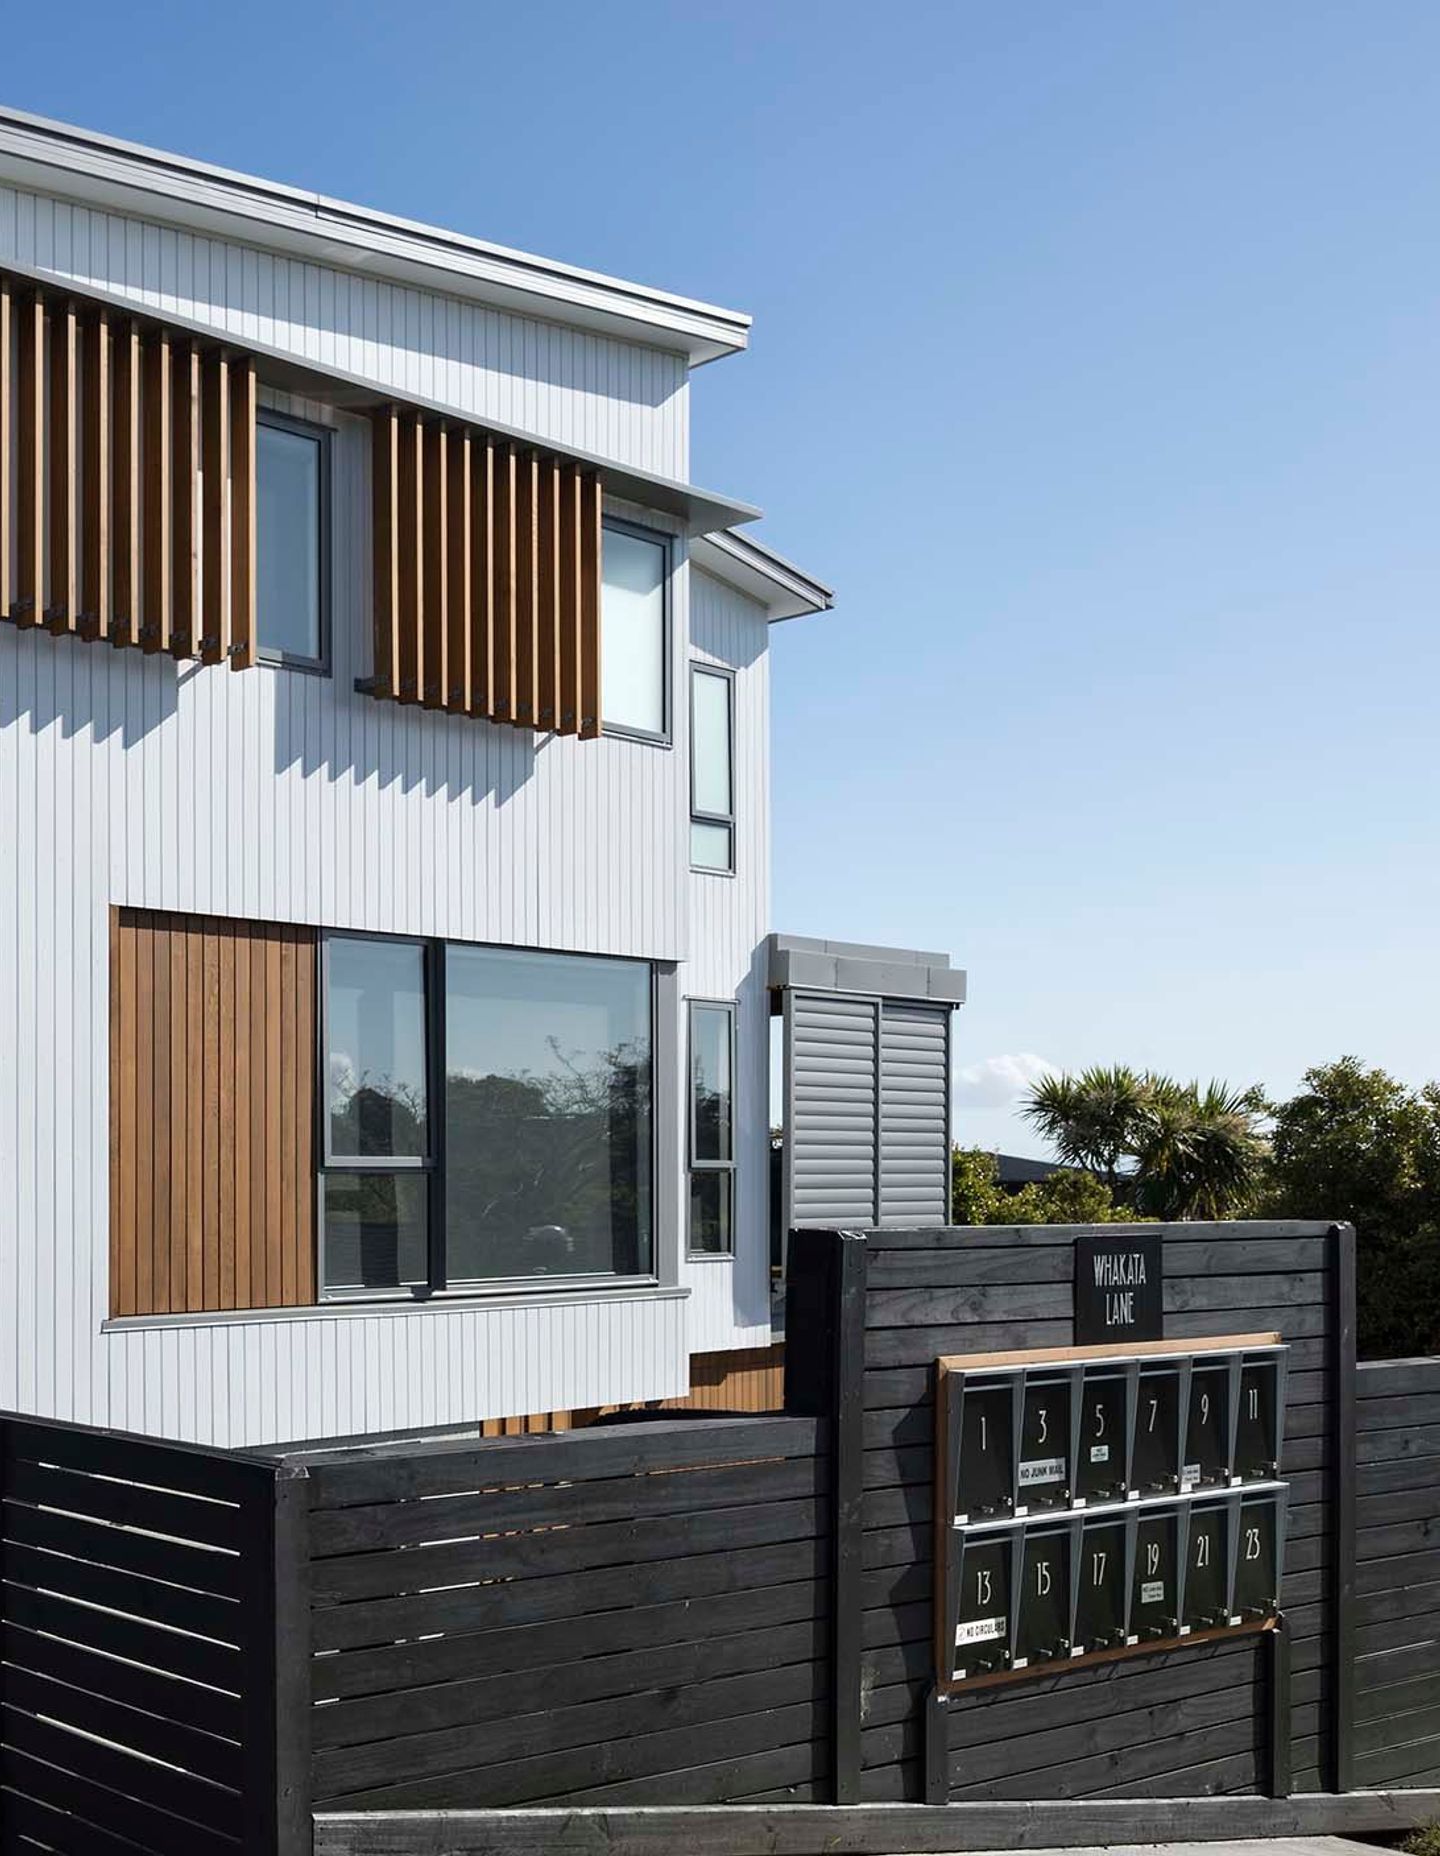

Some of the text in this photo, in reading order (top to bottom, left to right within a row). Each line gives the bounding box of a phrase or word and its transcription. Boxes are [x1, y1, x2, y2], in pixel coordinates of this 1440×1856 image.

[1093, 1253, 1147, 1287] WHAKATA
[1105, 1291, 1135, 1326] LANE
[1095, 1404, 1104, 1437] 5
[1148, 1399, 1157, 1432] 7
[1201, 1393, 1209, 1425] 9
[1248, 1388, 1258, 1420] 11
[981, 1416, 987, 1451] 1
[1038, 1409, 1047, 1443] 3
[1019, 1468, 1030, 1479] NO
[1031, 1465, 1048, 1478] JUNK
[1147, 1543, 1160, 1576] 19
[1196, 1535, 1209, 1568] 21
[1245, 1528, 1261, 1560] 23
[1036, 1561, 1051, 1596] 15
[1093, 1552, 1107, 1586] 17
[977, 1570, 992, 1605] 13
